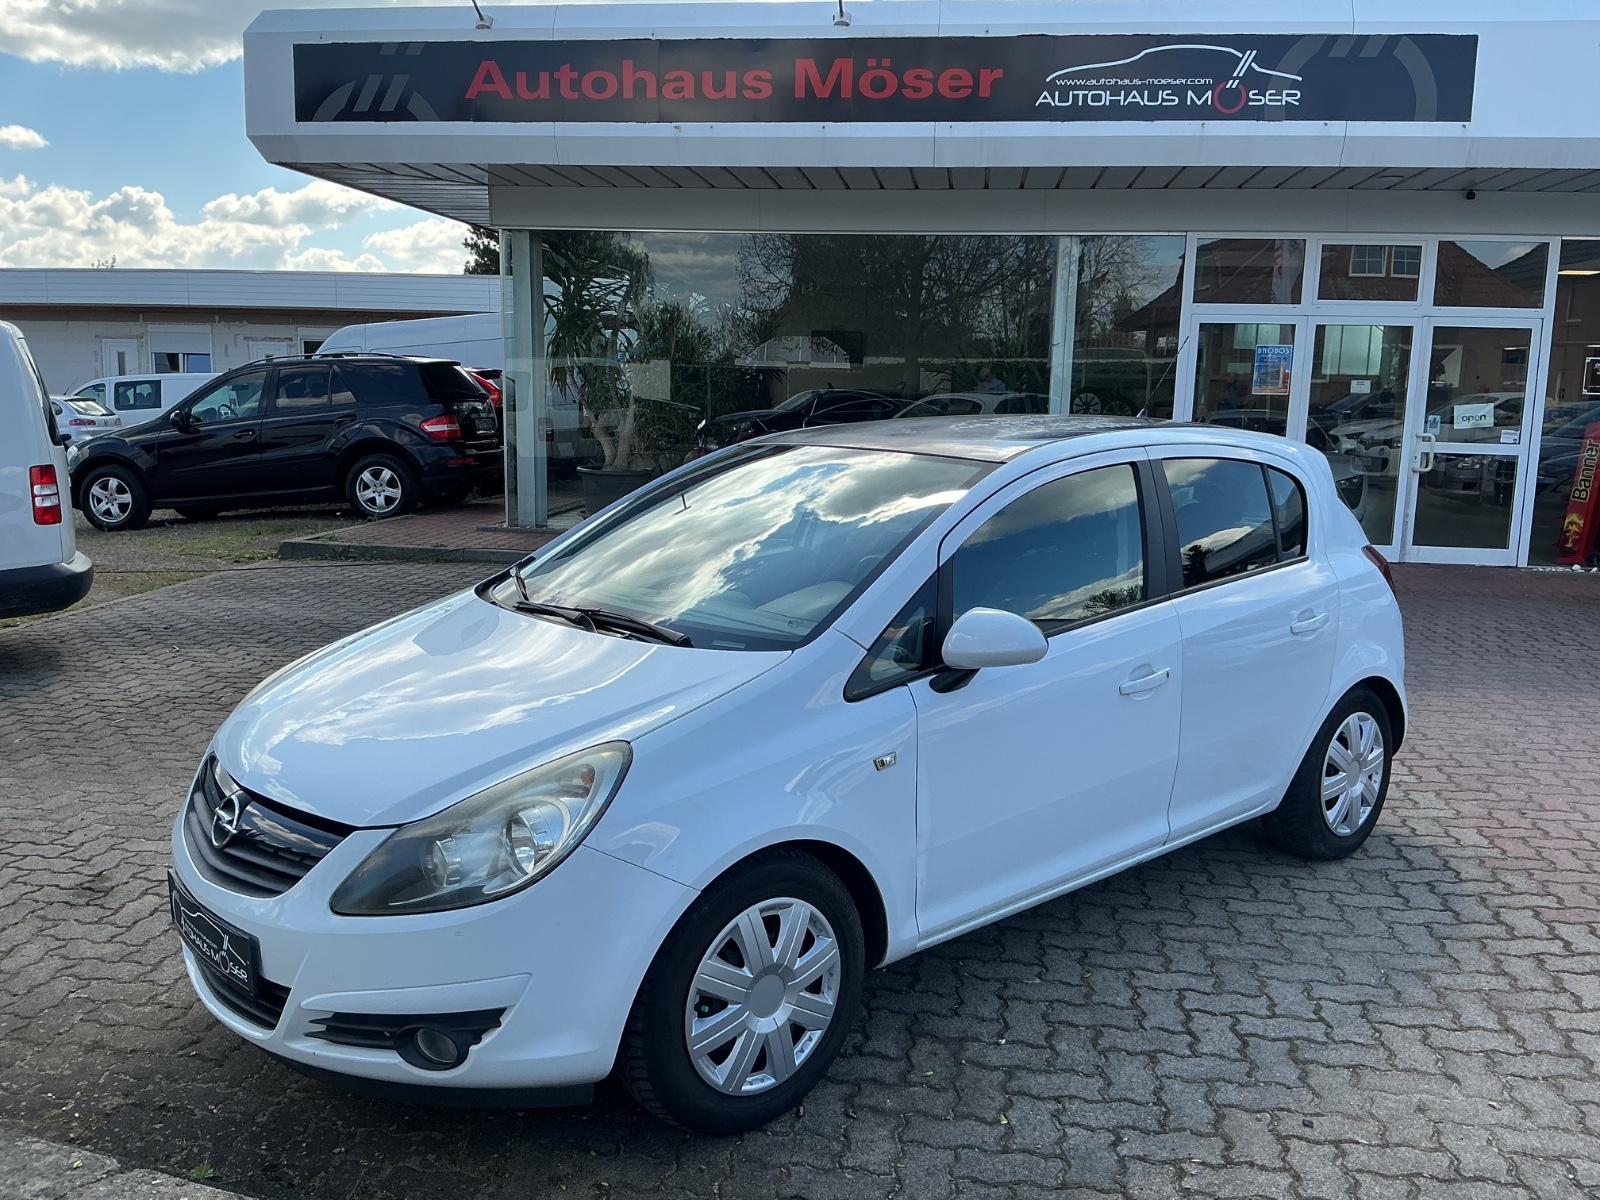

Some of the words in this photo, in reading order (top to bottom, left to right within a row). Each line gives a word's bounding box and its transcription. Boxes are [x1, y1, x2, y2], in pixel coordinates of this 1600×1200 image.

[464, 59, 773, 100] Autohaus
[794, 57, 1004, 99] Möser
[1055, 77, 1213, 87] www.autohaus-moeser.com
[1035, 89, 1179, 107] AUTOHAUS
[1186, 80, 1302, 114] MÖSER
[1461, 414, 1487, 424] open
[1571, 440, 1600, 502] Banner
